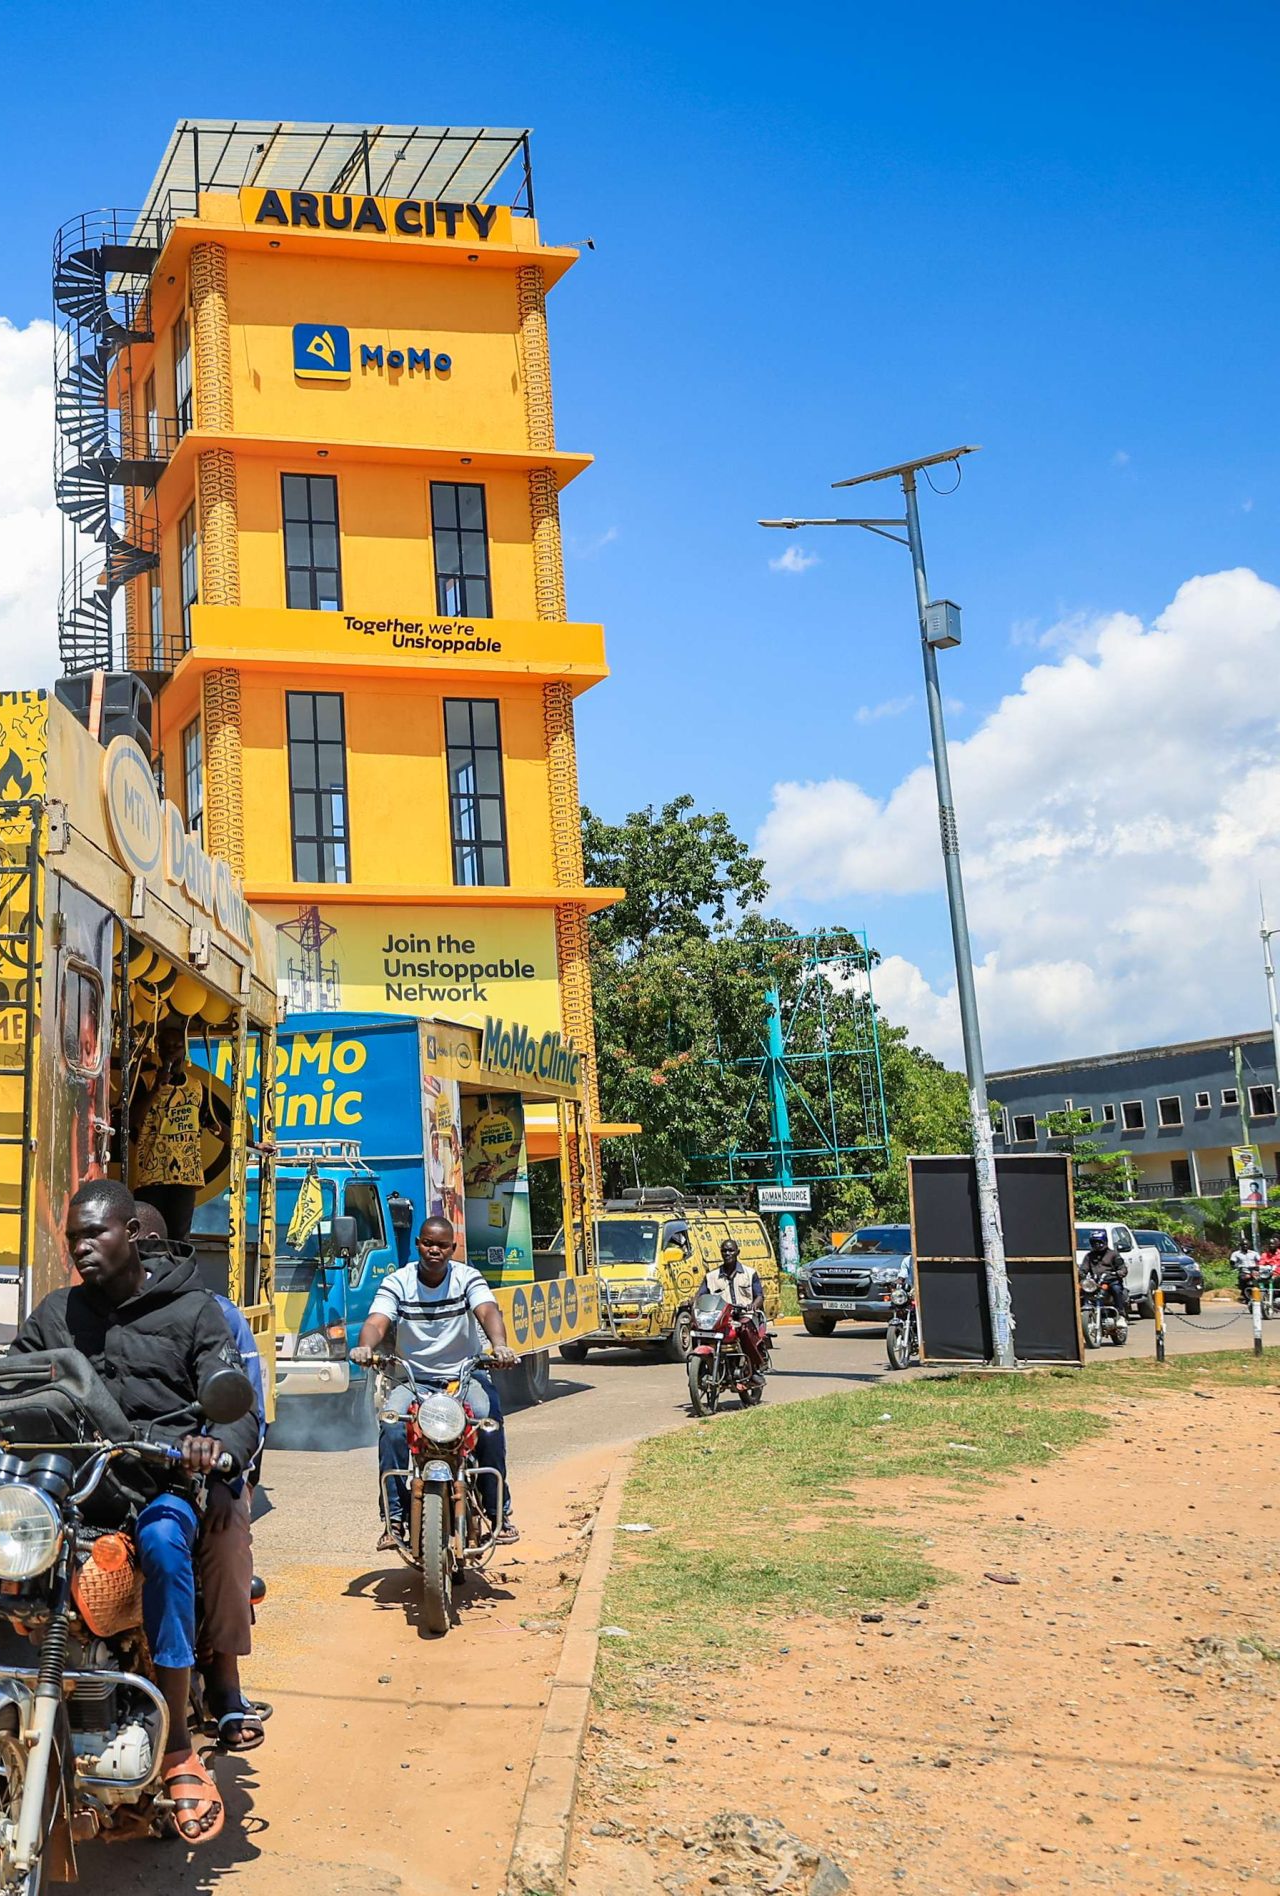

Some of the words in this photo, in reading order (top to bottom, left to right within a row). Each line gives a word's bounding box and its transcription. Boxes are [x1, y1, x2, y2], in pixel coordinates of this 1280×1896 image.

[255, 189, 387, 232] ARUA
[395, 200, 498, 242] CITY
[360, 344, 452, 372] MoMo
[343, 615, 424, 637] Together,
[429, 621, 474, 636] we're
[392, 633, 502, 655] Unstoppable
[125, 779, 151, 841] MTN
[171, 809, 213, 910] Data
[381, 934, 430, 955] Join
[436, 935, 476, 954] the
[384, 958, 535, 986] Unstoppable
[385, 983, 488, 1002] Network
[483, 1015, 536, 1073] MoMo
[538, 1030, 579, 1086] Clinic
[169, 1113, 190, 1126] your
[171, 1107, 192, 1117] Free
[177, 1122, 194, 1132] fire
[167, 1134, 194, 1143] MEDIA
[481, 1131, 513, 1147] FREE
[783, 1190, 807, 1201] SOURCE
